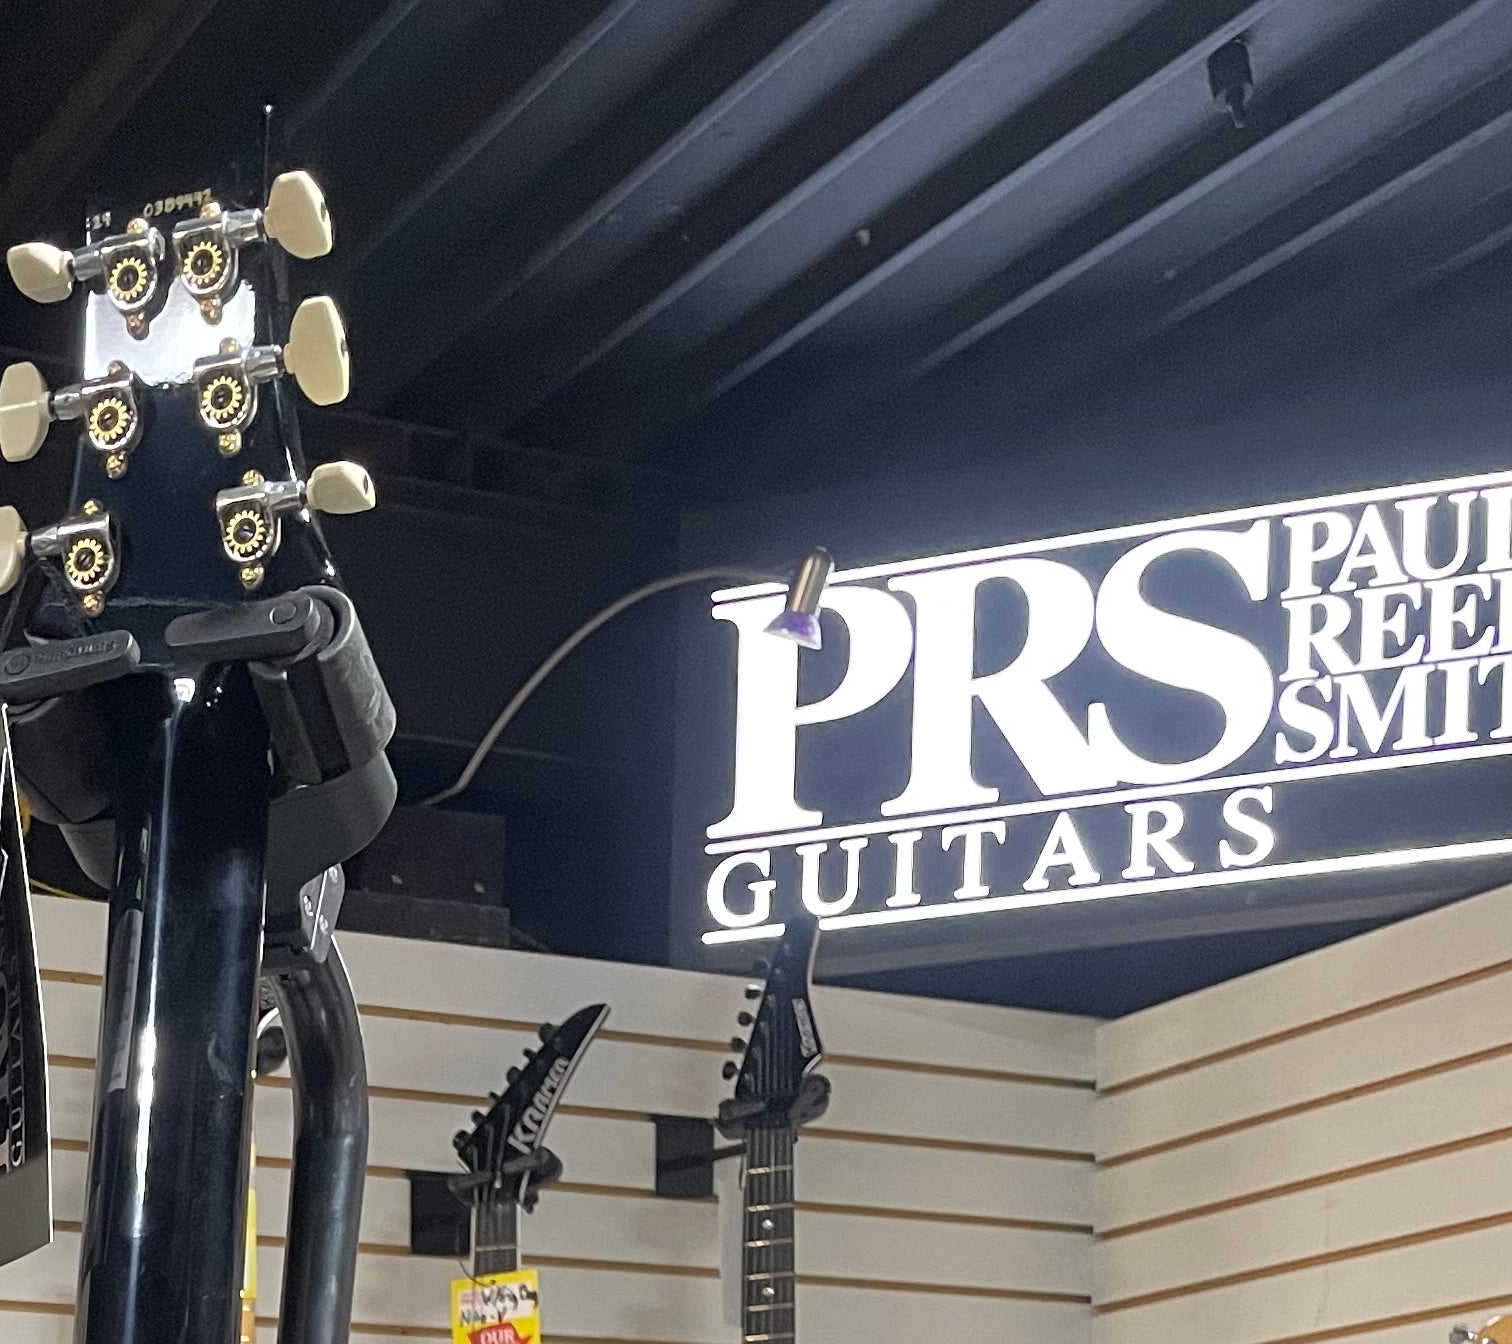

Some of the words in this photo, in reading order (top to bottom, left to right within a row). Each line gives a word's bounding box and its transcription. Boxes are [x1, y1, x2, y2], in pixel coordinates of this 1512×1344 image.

[708, 516, 1275, 841] PRS
[1278, 570, 1512, 682] REE
[704, 784, 1276, 930] GUITARS
